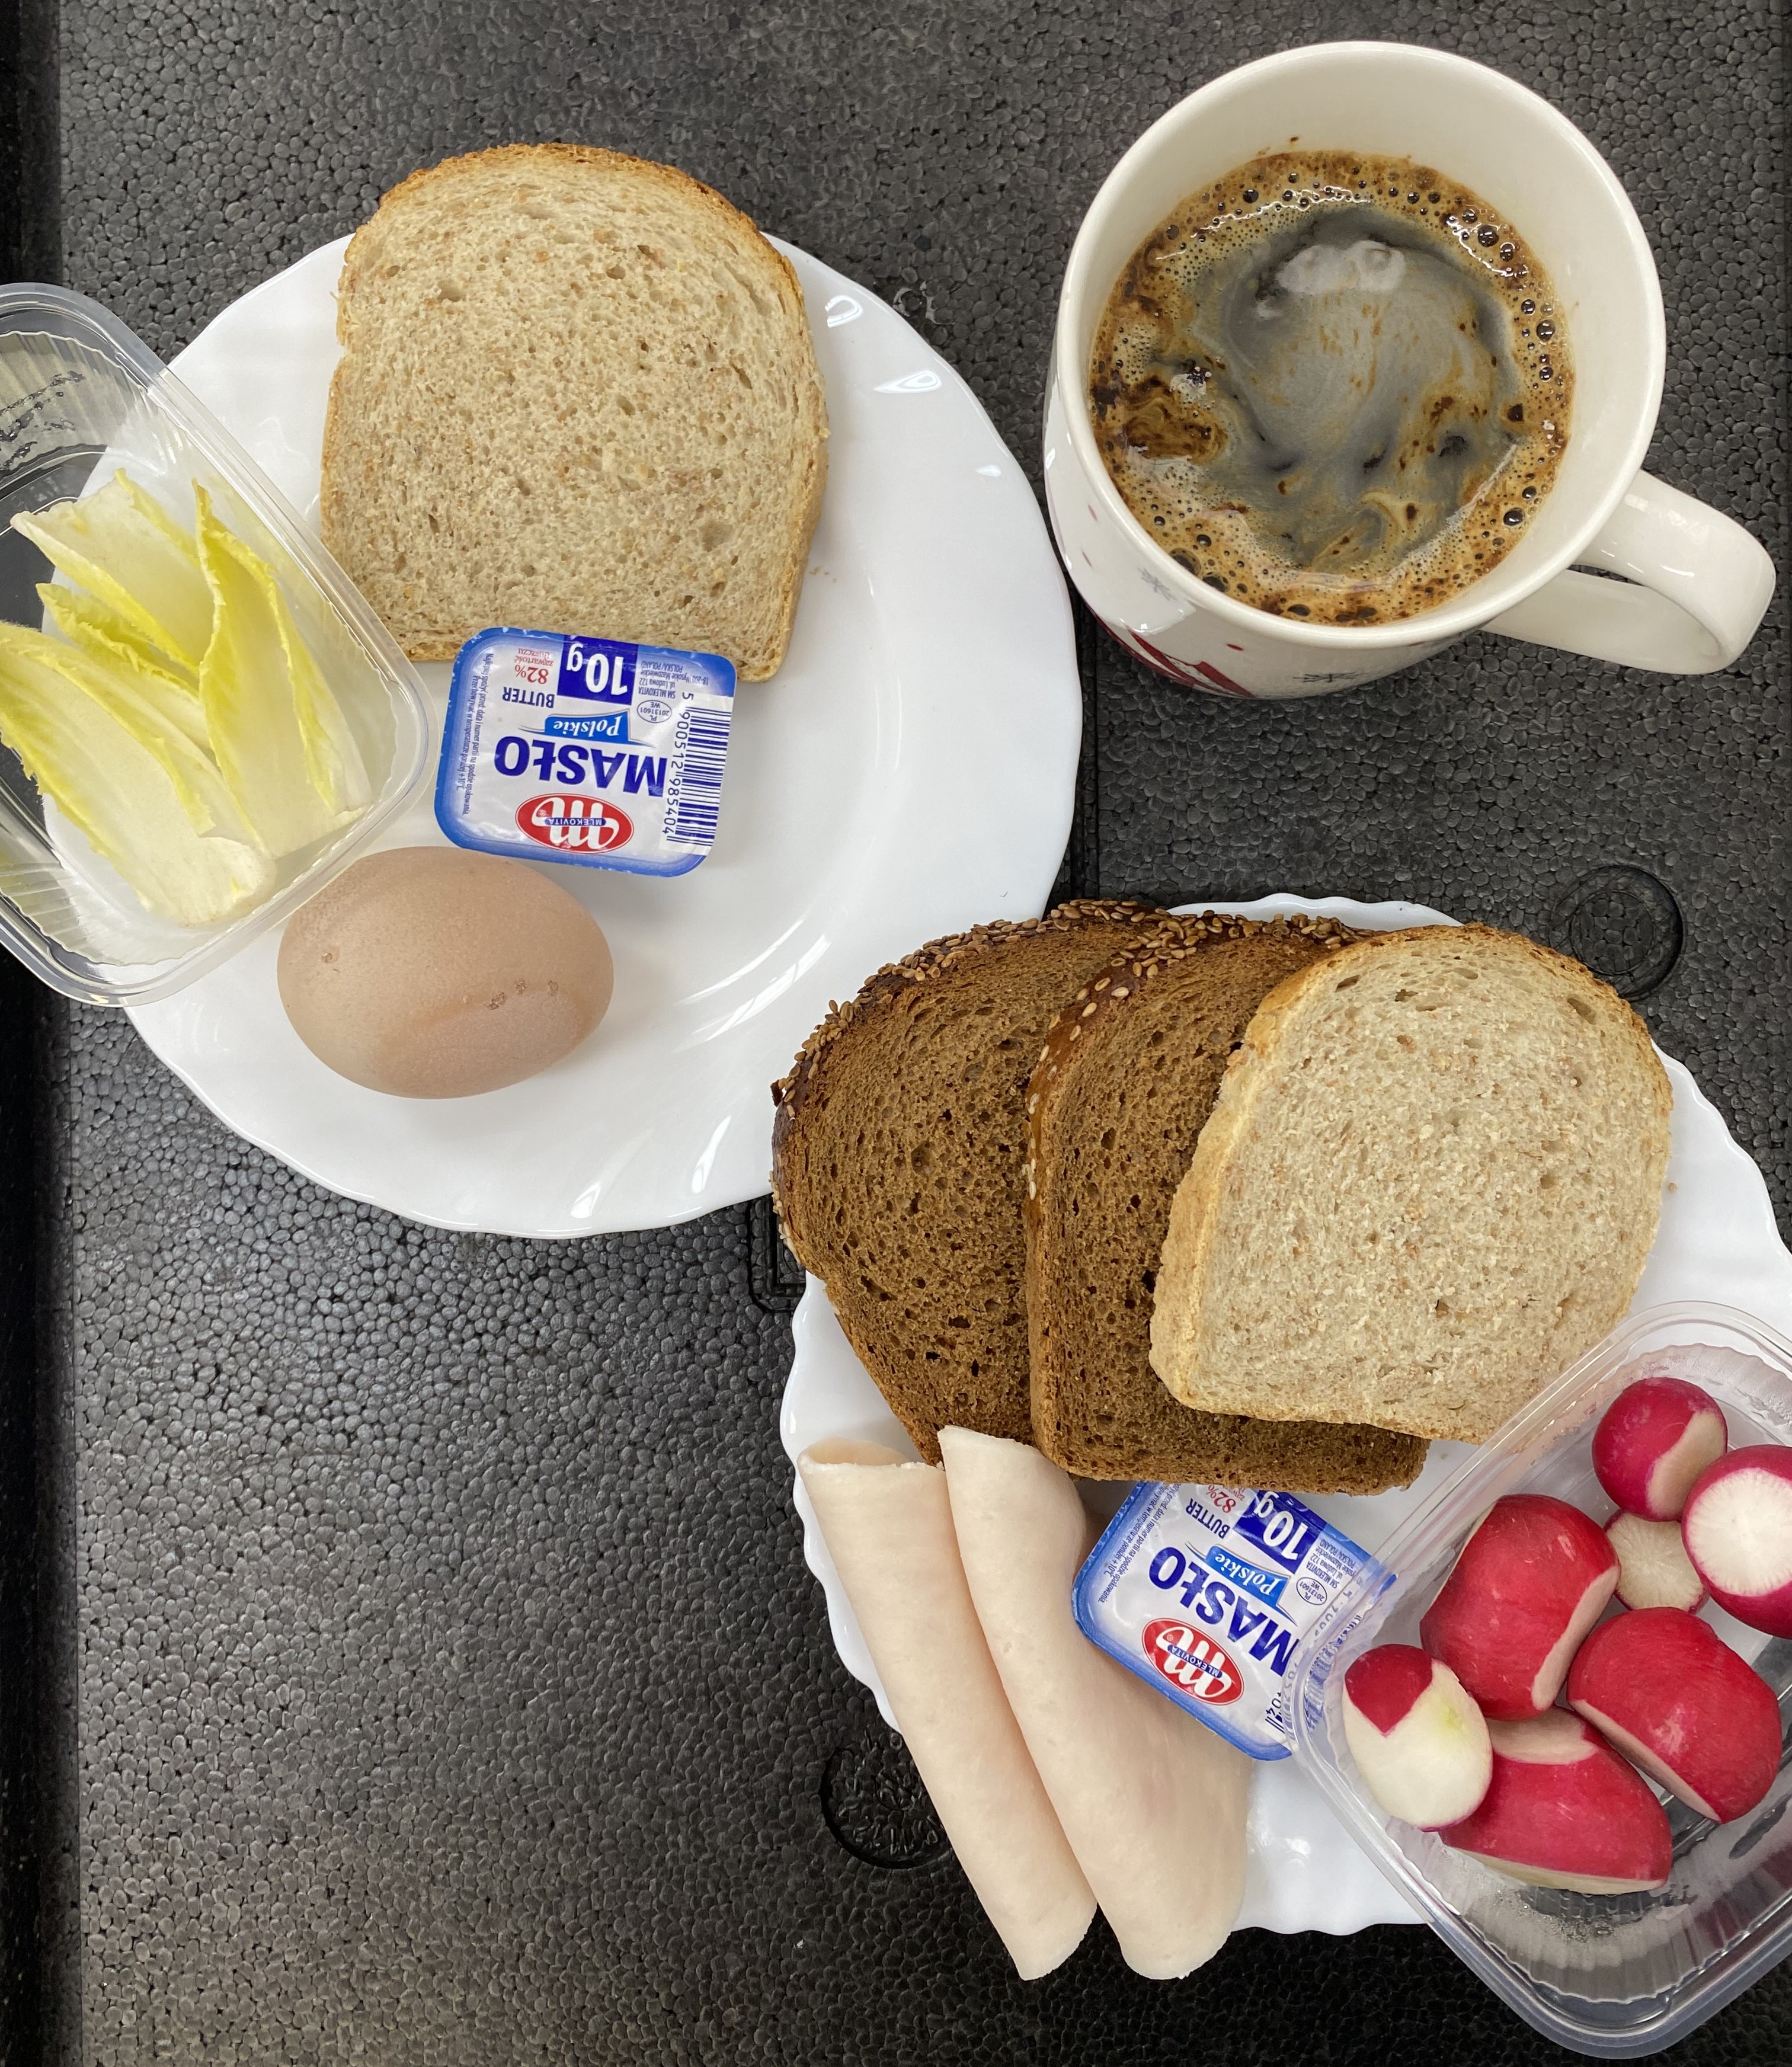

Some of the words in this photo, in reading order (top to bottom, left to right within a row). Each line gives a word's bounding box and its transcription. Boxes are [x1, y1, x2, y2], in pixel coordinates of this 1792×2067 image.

[514, 664, 549, 684] 82%
[639, 677, 648, 686] 122
[638, 686, 667, 698] MLEKOVITA
[649, 679, 668, 689] Ludowa
[502, 687, 555, 709] BUTTER
[667, 690, 676, 699] SM
[475, 709, 485, 722] data
[640, 706, 670, 716] 20131601
[473, 724, 481, 743] numer
[553, 715, 623, 738] Polskie
[466, 763, 476, 783] spodzie
[494, 736, 667, 798] MASŁO
[662, 778, 681, 834] 985404
[547, 818, 602, 826] MLEKOVITA
[1206, 1485, 1236, 1514] 82%
[1153, 1508, 1164, 1522] data
[1185, 1498, 1231, 1540] BUTTER
[1141, 1521, 1155, 1539] numer
[1113, 1540, 1129, 1563] poniżej
[1310, 1553, 1320, 1564] 122
[1116, 1556, 1132, 1575] spodzie
[1214, 1553, 1282, 1596] Polskie
[1305, 1561, 1332, 1584] MLEKOVITA
[1320, 1559, 1338, 1576] Ludowa
[1299, 1581, 1325, 1602] 20131601
[1310, 1580, 1320, 1591] WE
[1329, 1579, 1339, 1589] SM
[1304, 1592, 1311, 1601] PL
[1148, 1547, 1300, 1677] MASŁO
[1171, 1645, 1220, 1677] MLEKOVITA
